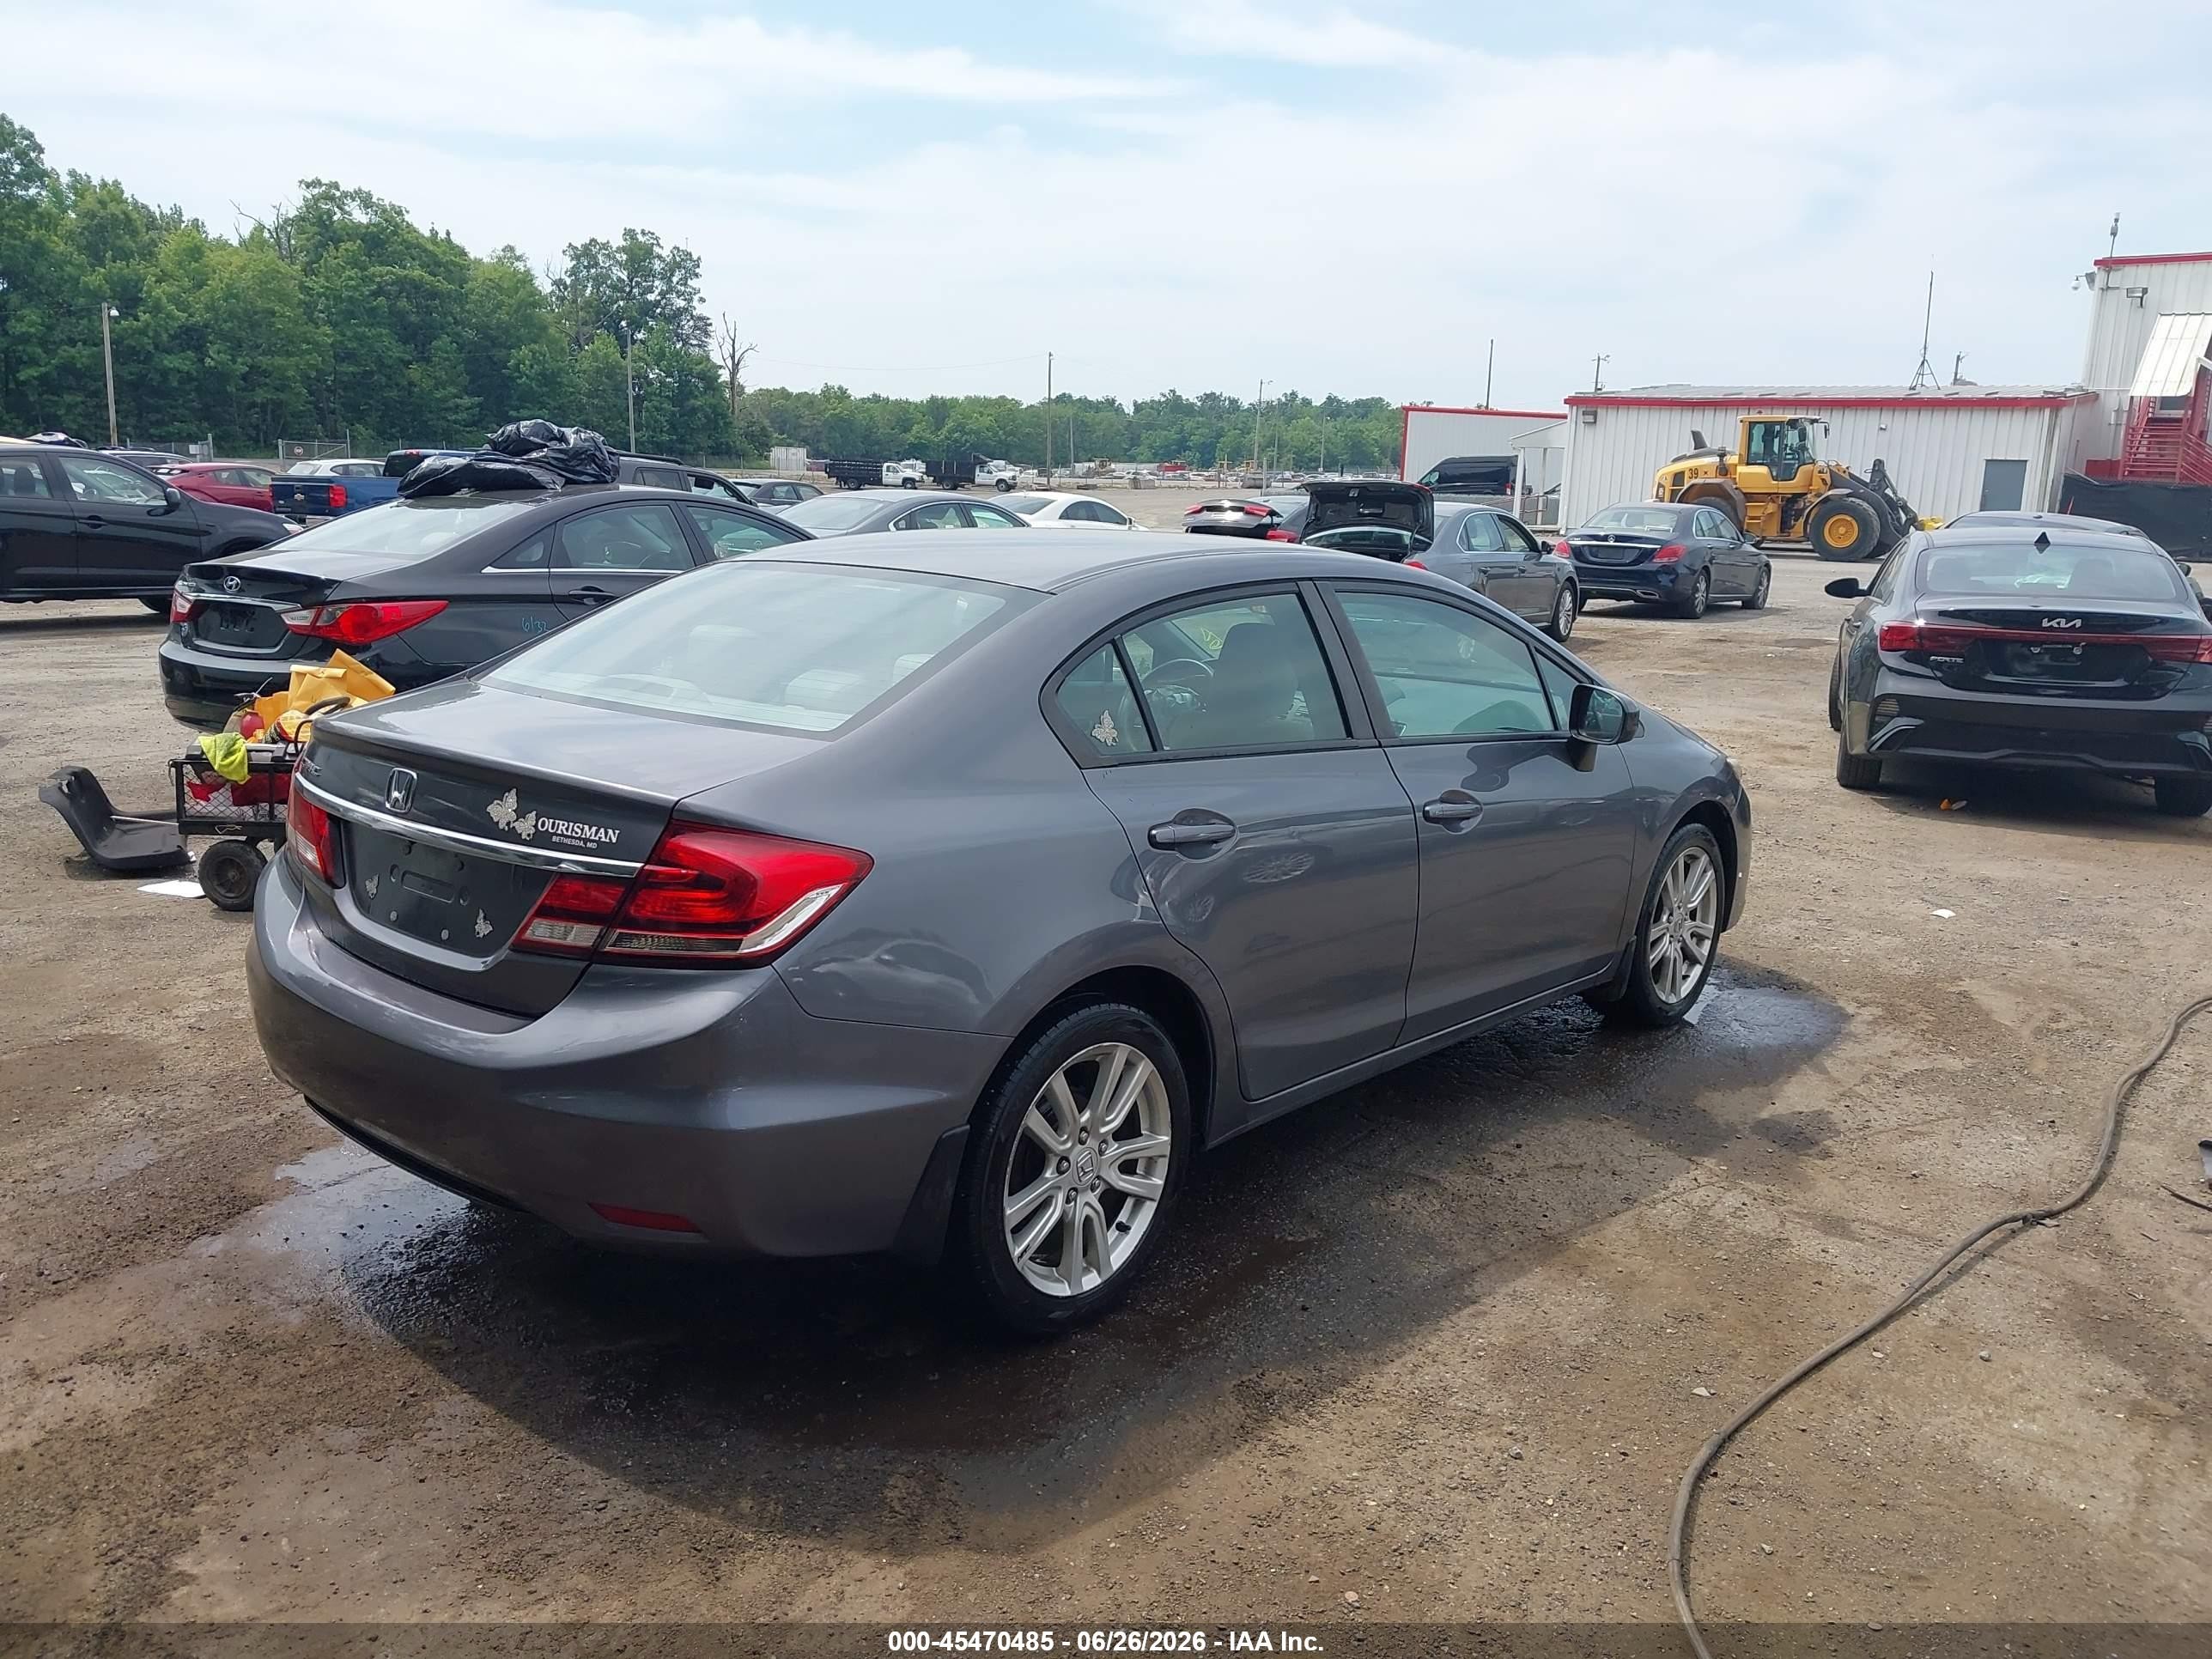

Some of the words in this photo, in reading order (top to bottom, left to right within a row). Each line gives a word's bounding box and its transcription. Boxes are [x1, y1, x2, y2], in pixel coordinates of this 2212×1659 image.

[1688, 468, 1698, 479] 39
[2042, 618, 2082, 629] KIA
[538, 817, 620, 843] OURISMAN
[551, 836, 586, 848] BETHESDA,
